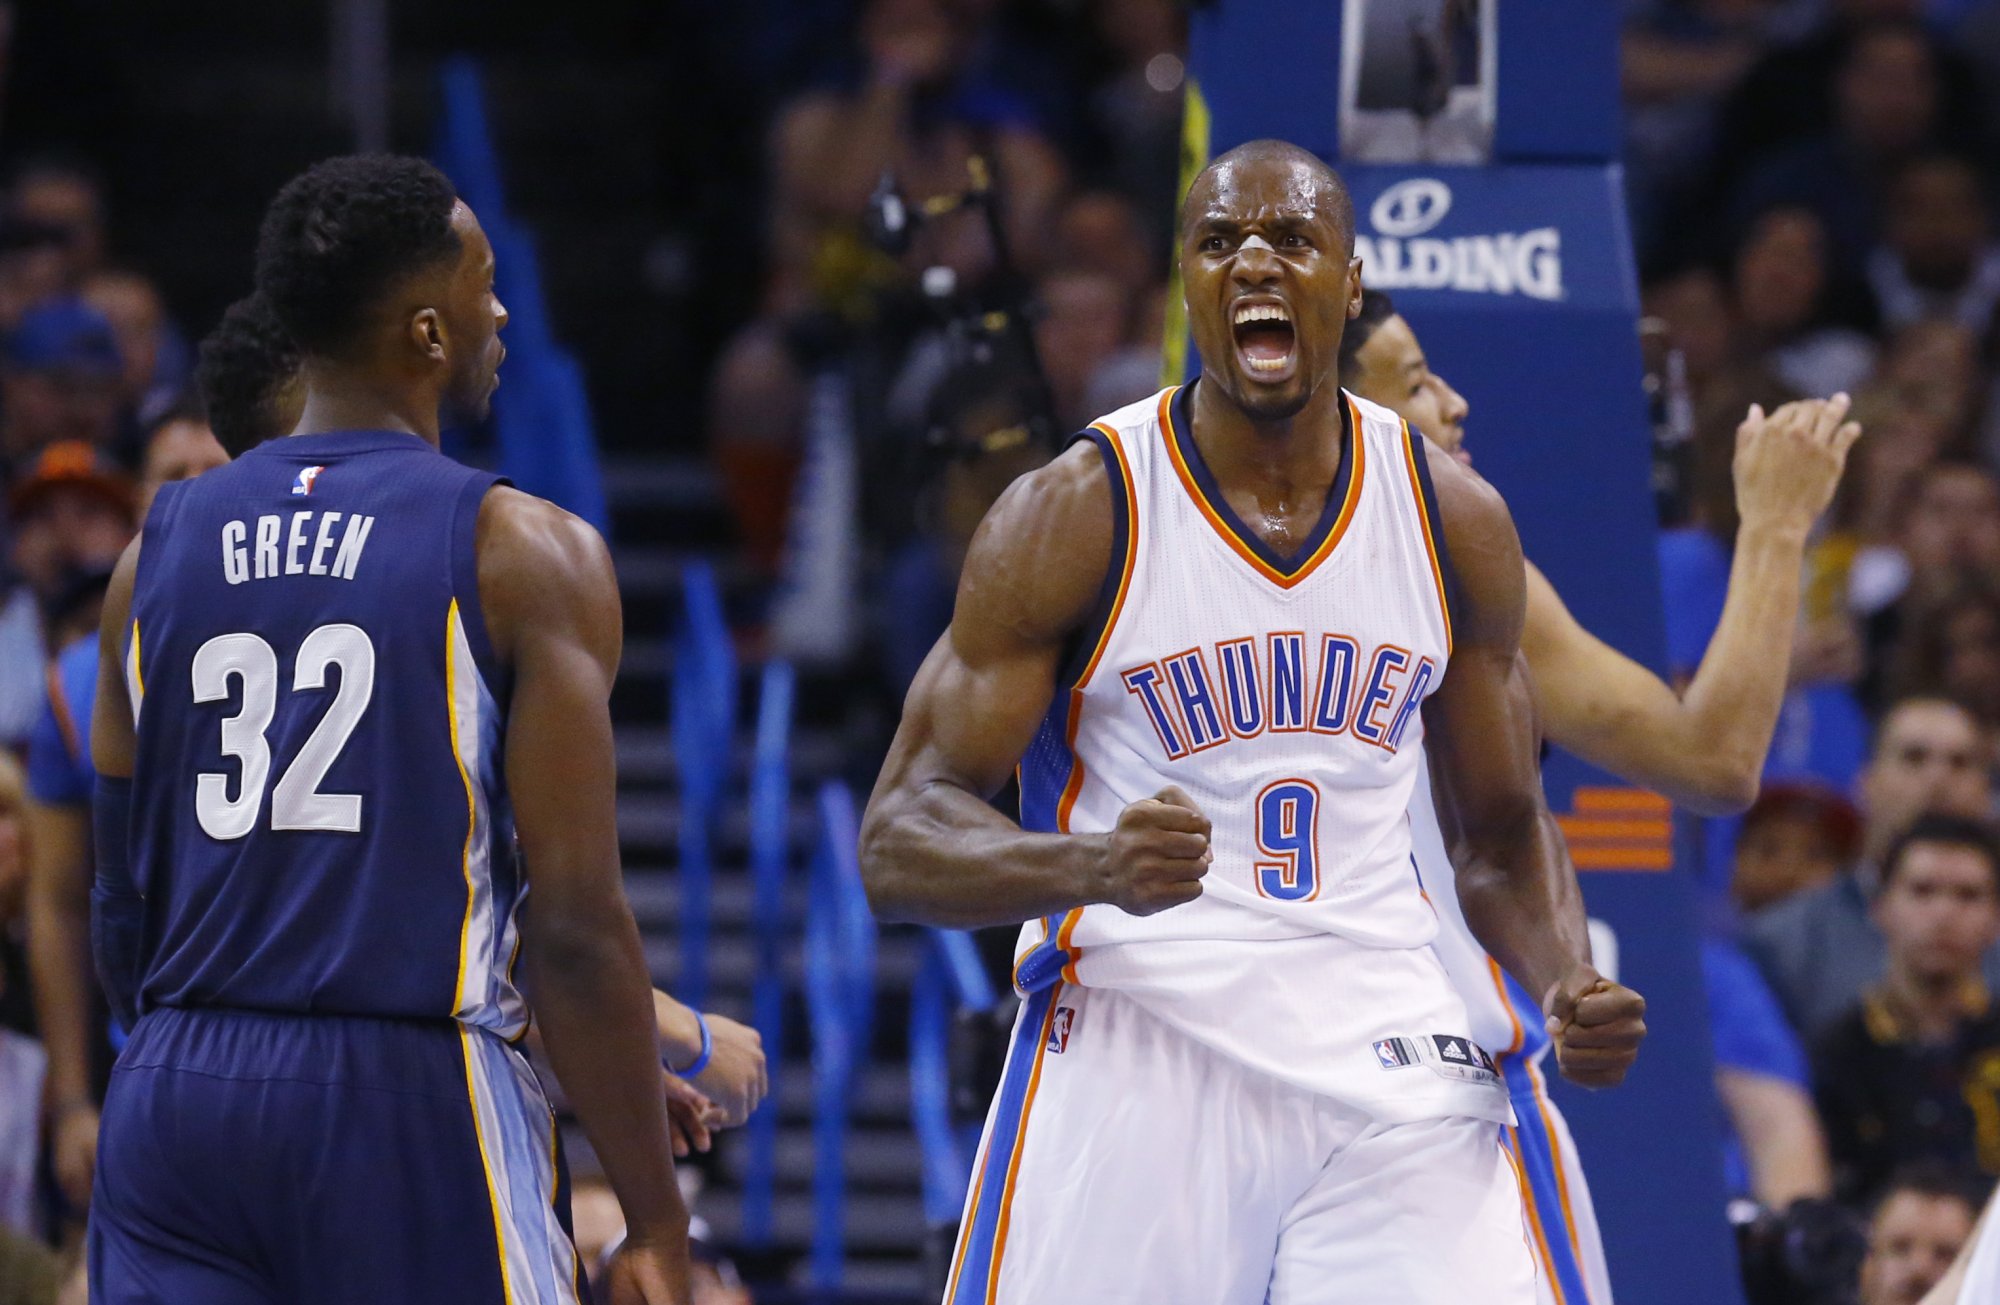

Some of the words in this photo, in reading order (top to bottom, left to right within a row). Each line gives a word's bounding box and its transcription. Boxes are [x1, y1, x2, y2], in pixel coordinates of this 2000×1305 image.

[1353, 227, 1562, 300] ALDING
[221, 511, 374, 585] GREEN
[192, 623, 375, 840] 32
[1121, 631, 1434, 761] THUNDER
[1255, 778, 1320, 902] 9
